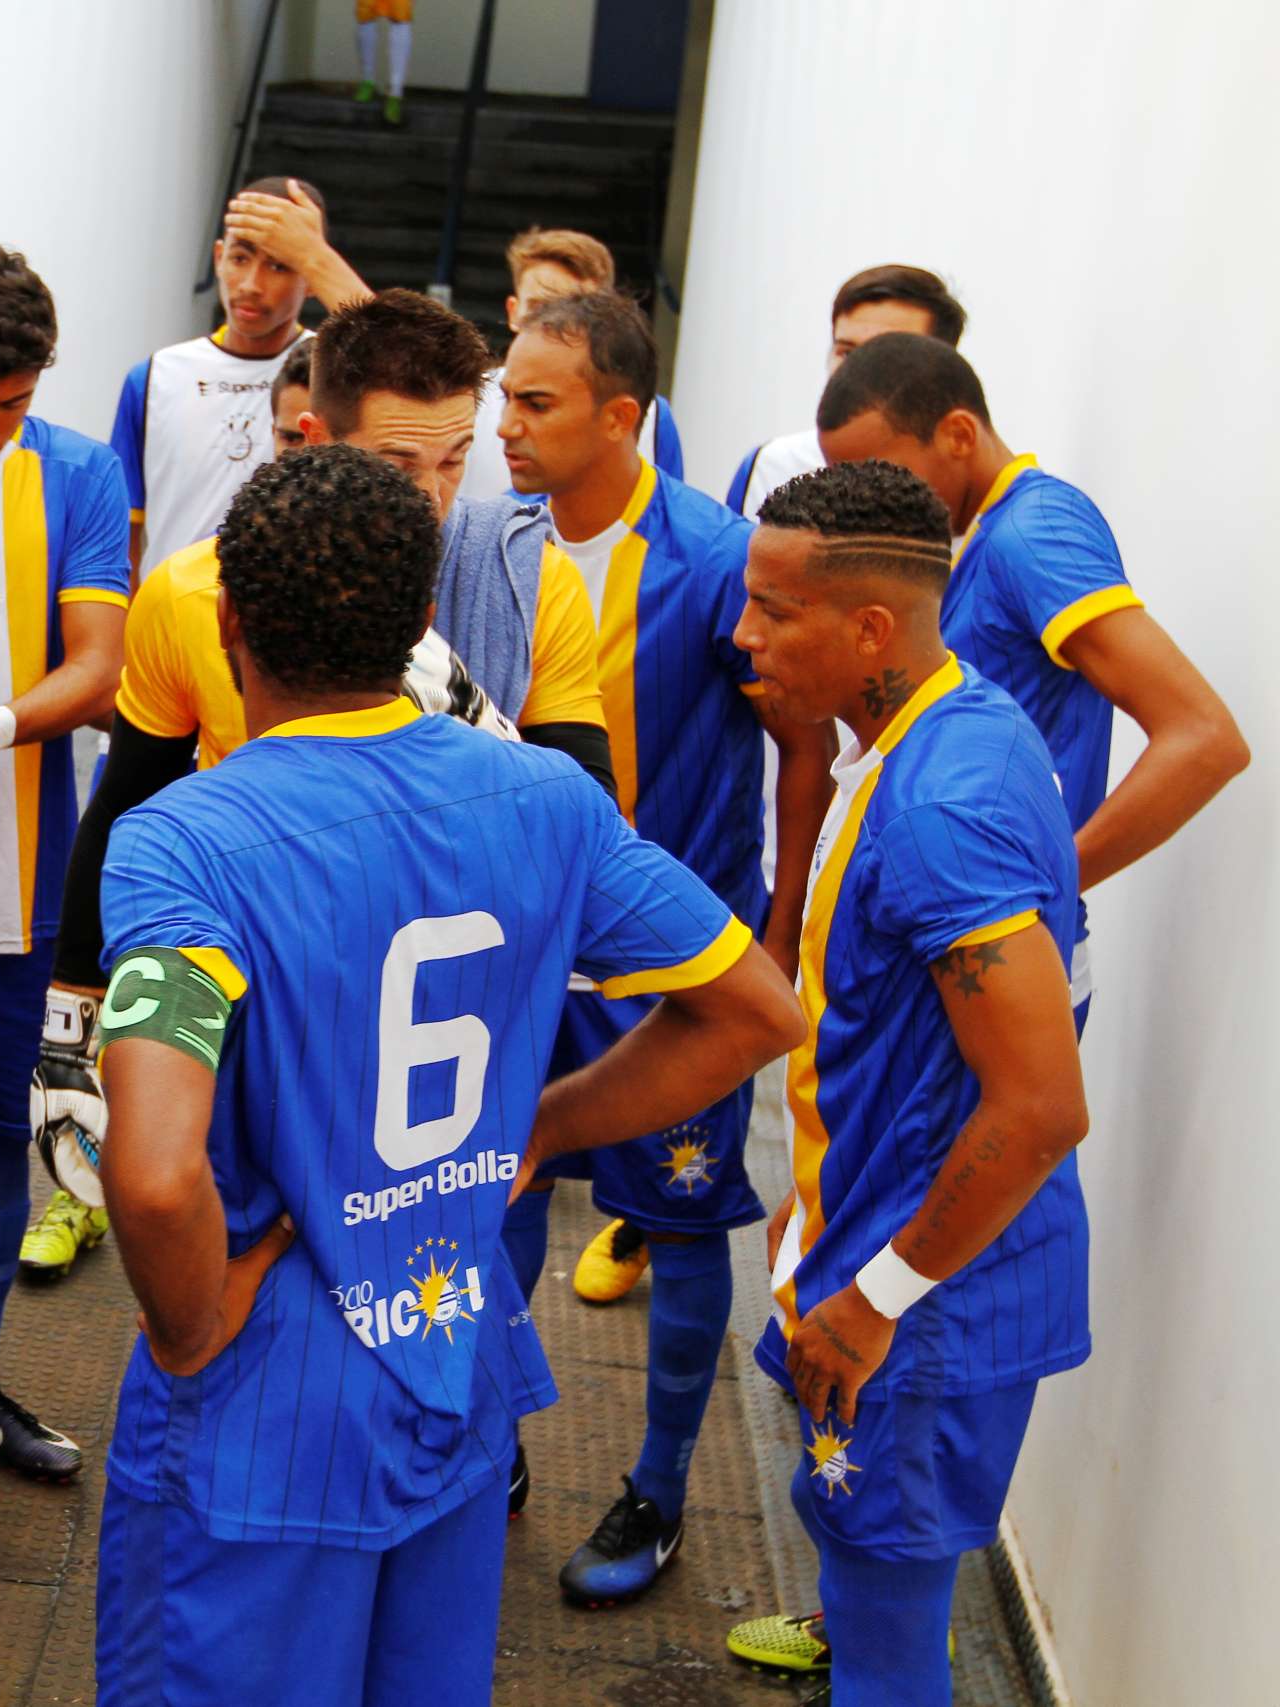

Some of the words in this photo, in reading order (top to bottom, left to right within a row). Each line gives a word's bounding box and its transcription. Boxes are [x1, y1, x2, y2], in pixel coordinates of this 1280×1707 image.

[100, 956, 166, 1030] C
[373, 910, 505, 1172] 6
[343, 1174, 434, 1226] Super
[437, 1149, 519, 1196] Bolla
